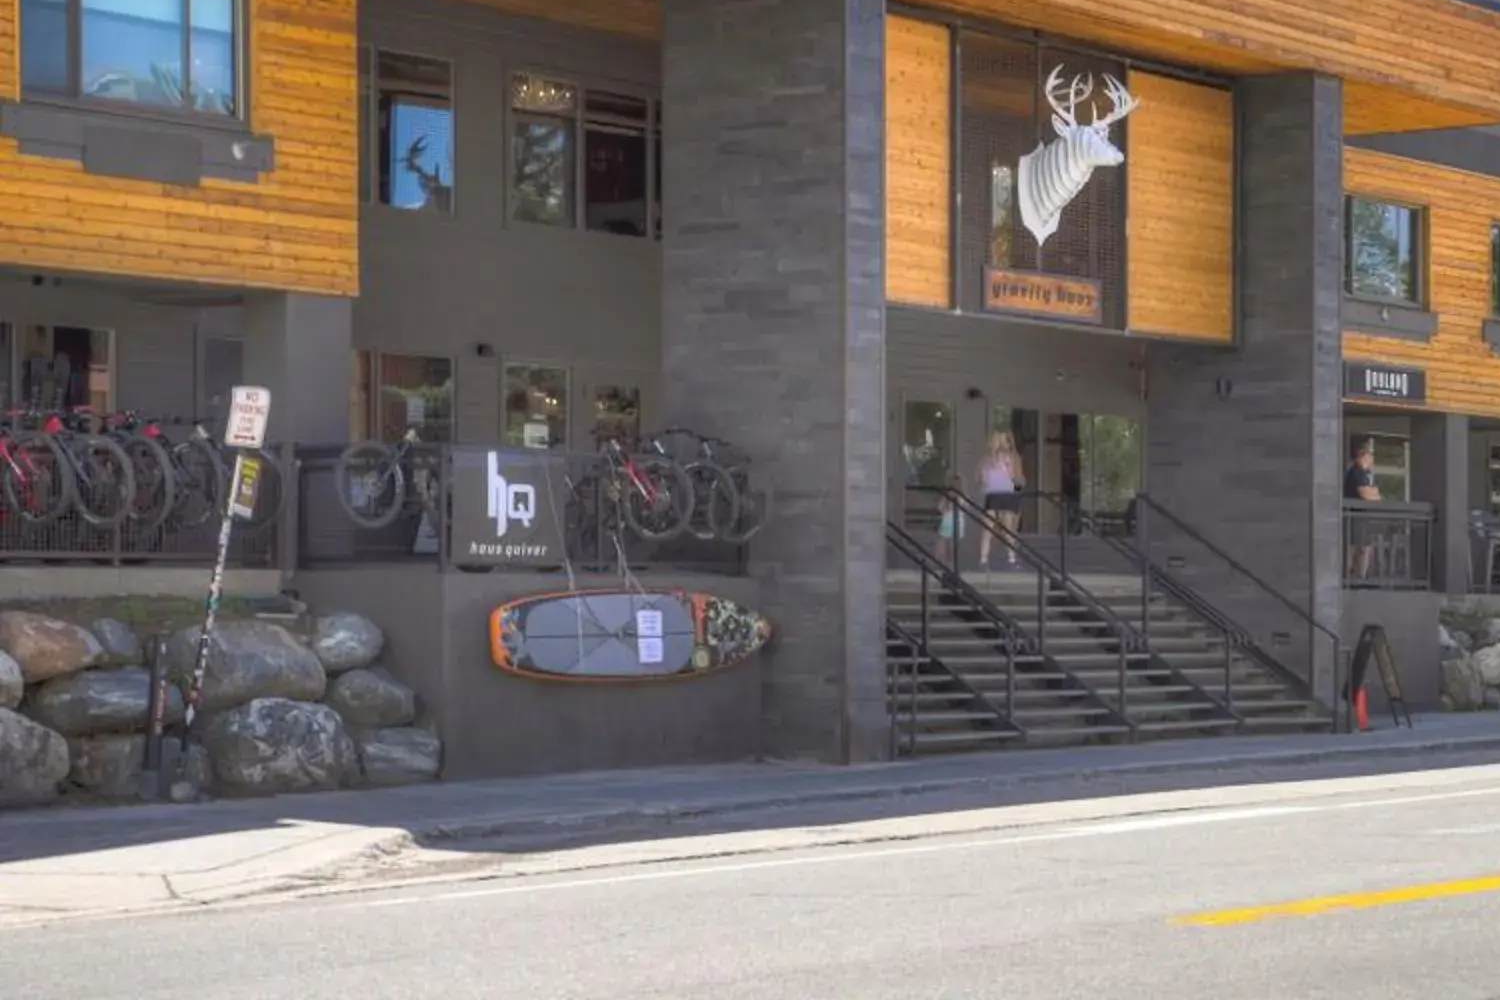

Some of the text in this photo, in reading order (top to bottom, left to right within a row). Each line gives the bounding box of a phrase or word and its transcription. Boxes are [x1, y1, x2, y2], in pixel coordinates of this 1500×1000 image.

[992, 283, 1051, 304] gravity
[245, 391, 259, 402] NO
[469, 541, 548, 560] haus quiver
